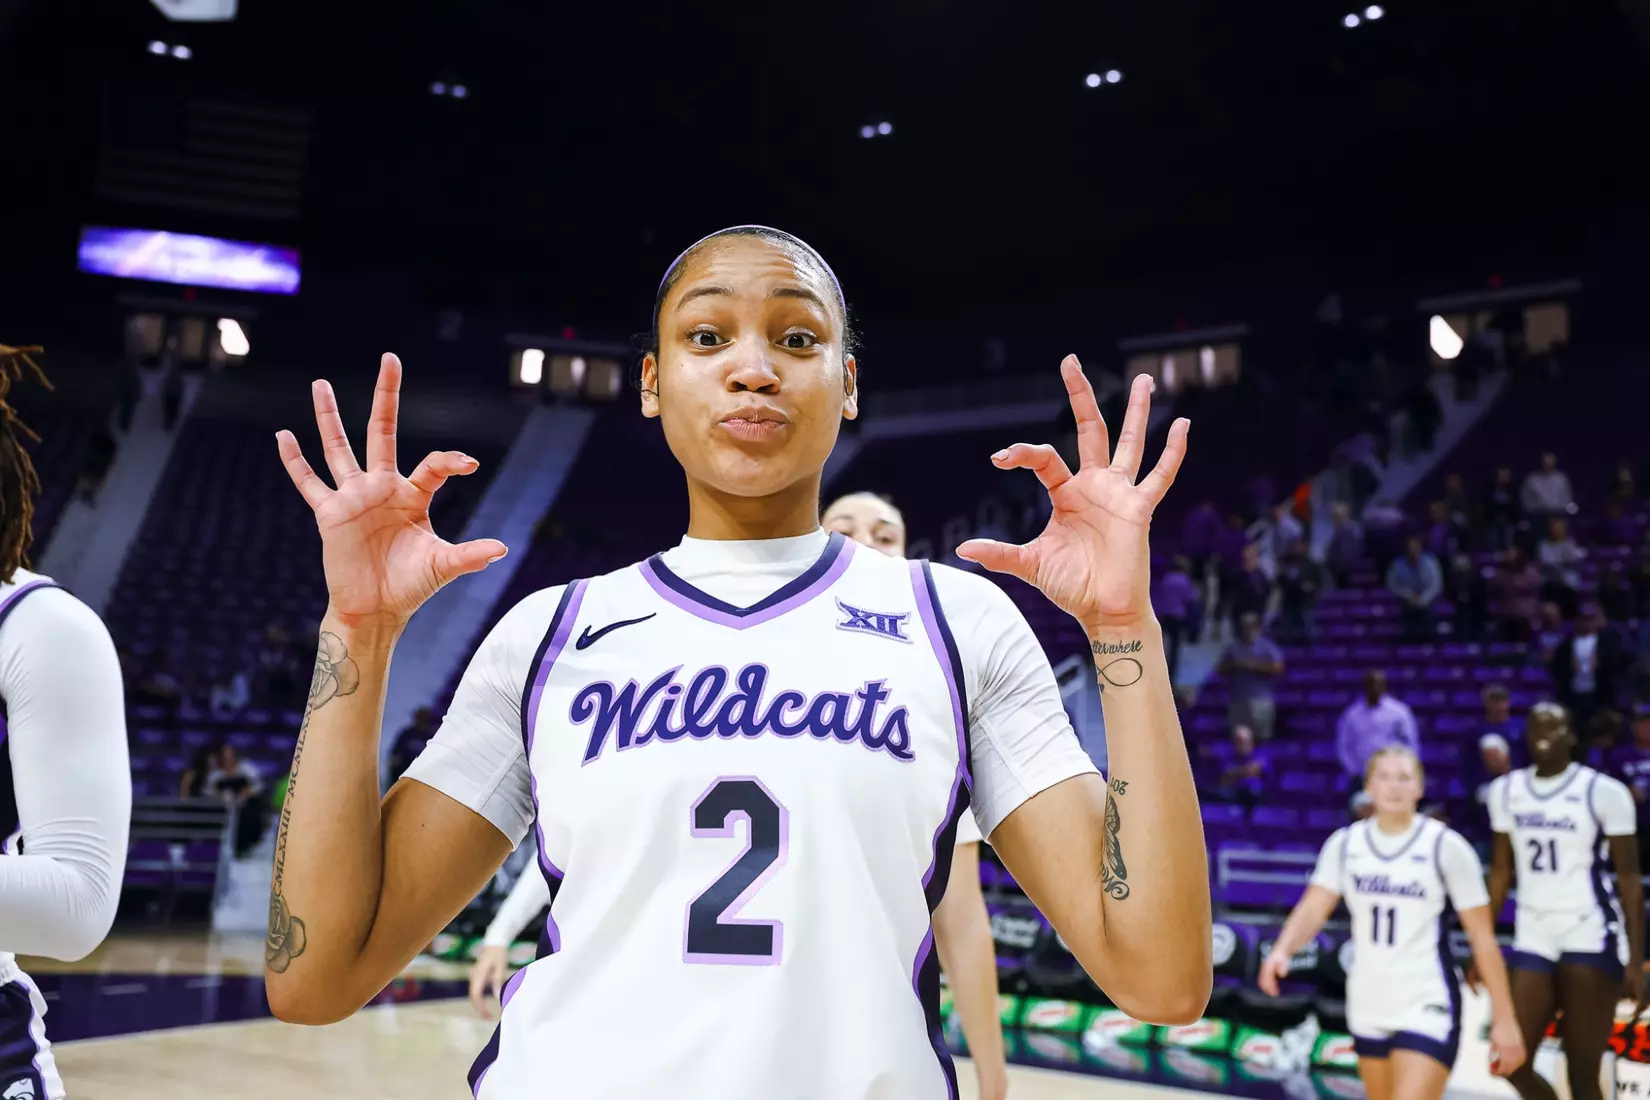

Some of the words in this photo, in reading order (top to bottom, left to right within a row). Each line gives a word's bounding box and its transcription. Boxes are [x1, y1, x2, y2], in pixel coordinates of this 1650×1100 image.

[837, 598, 911, 642] XII
[568, 662, 916, 767] Wildcats
[682, 774, 790, 966] 2
[1527, 838, 1558, 873] 21
[1371, 904, 1396, 945] 11
